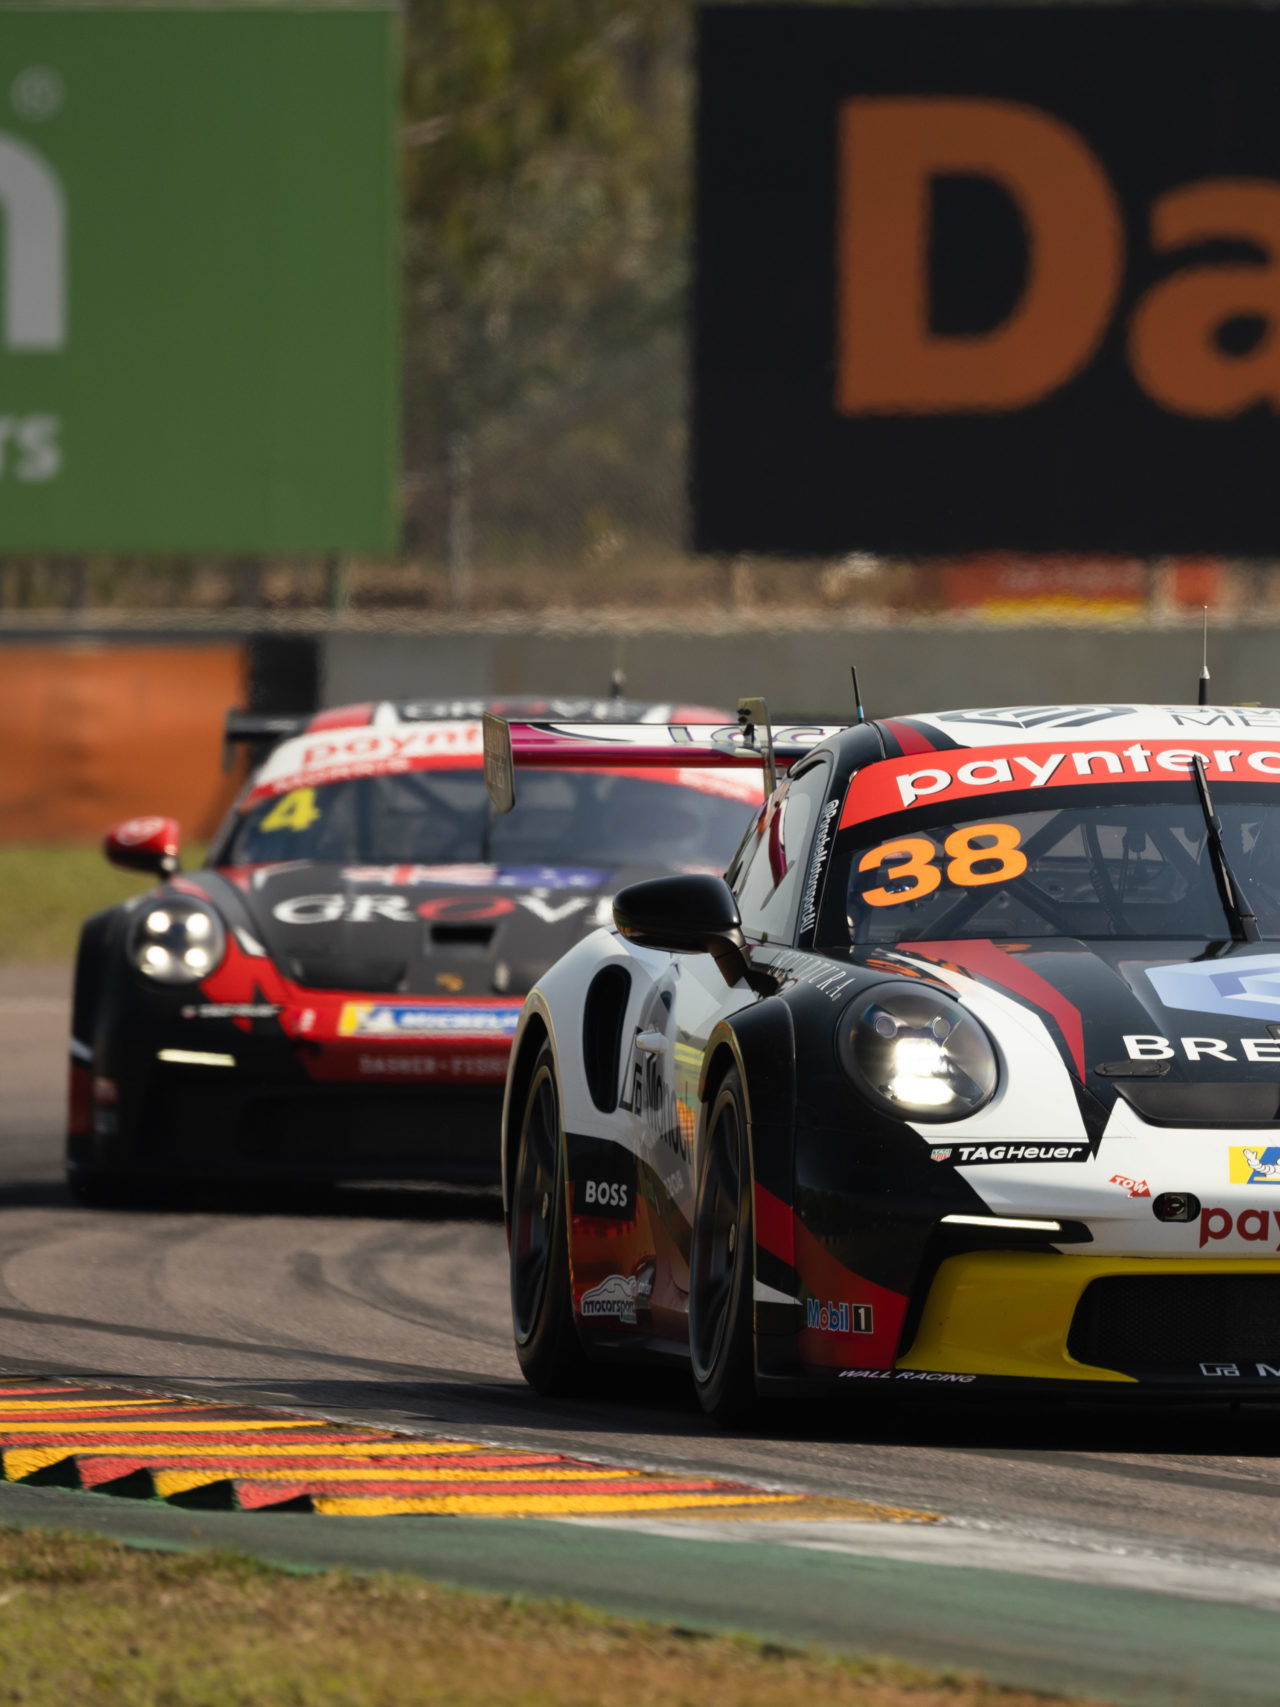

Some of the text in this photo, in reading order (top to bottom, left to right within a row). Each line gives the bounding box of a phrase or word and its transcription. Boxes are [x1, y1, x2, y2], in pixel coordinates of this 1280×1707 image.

[259, 787, 319, 832] 4
[858, 823, 1028, 907] 38
[585, 1180, 628, 1207] BOSS
[1113, 1175, 1148, 1193] TOW
[807, 1298, 849, 1333] Mobil
[838, 1369, 977, 1383] WALL RACING
